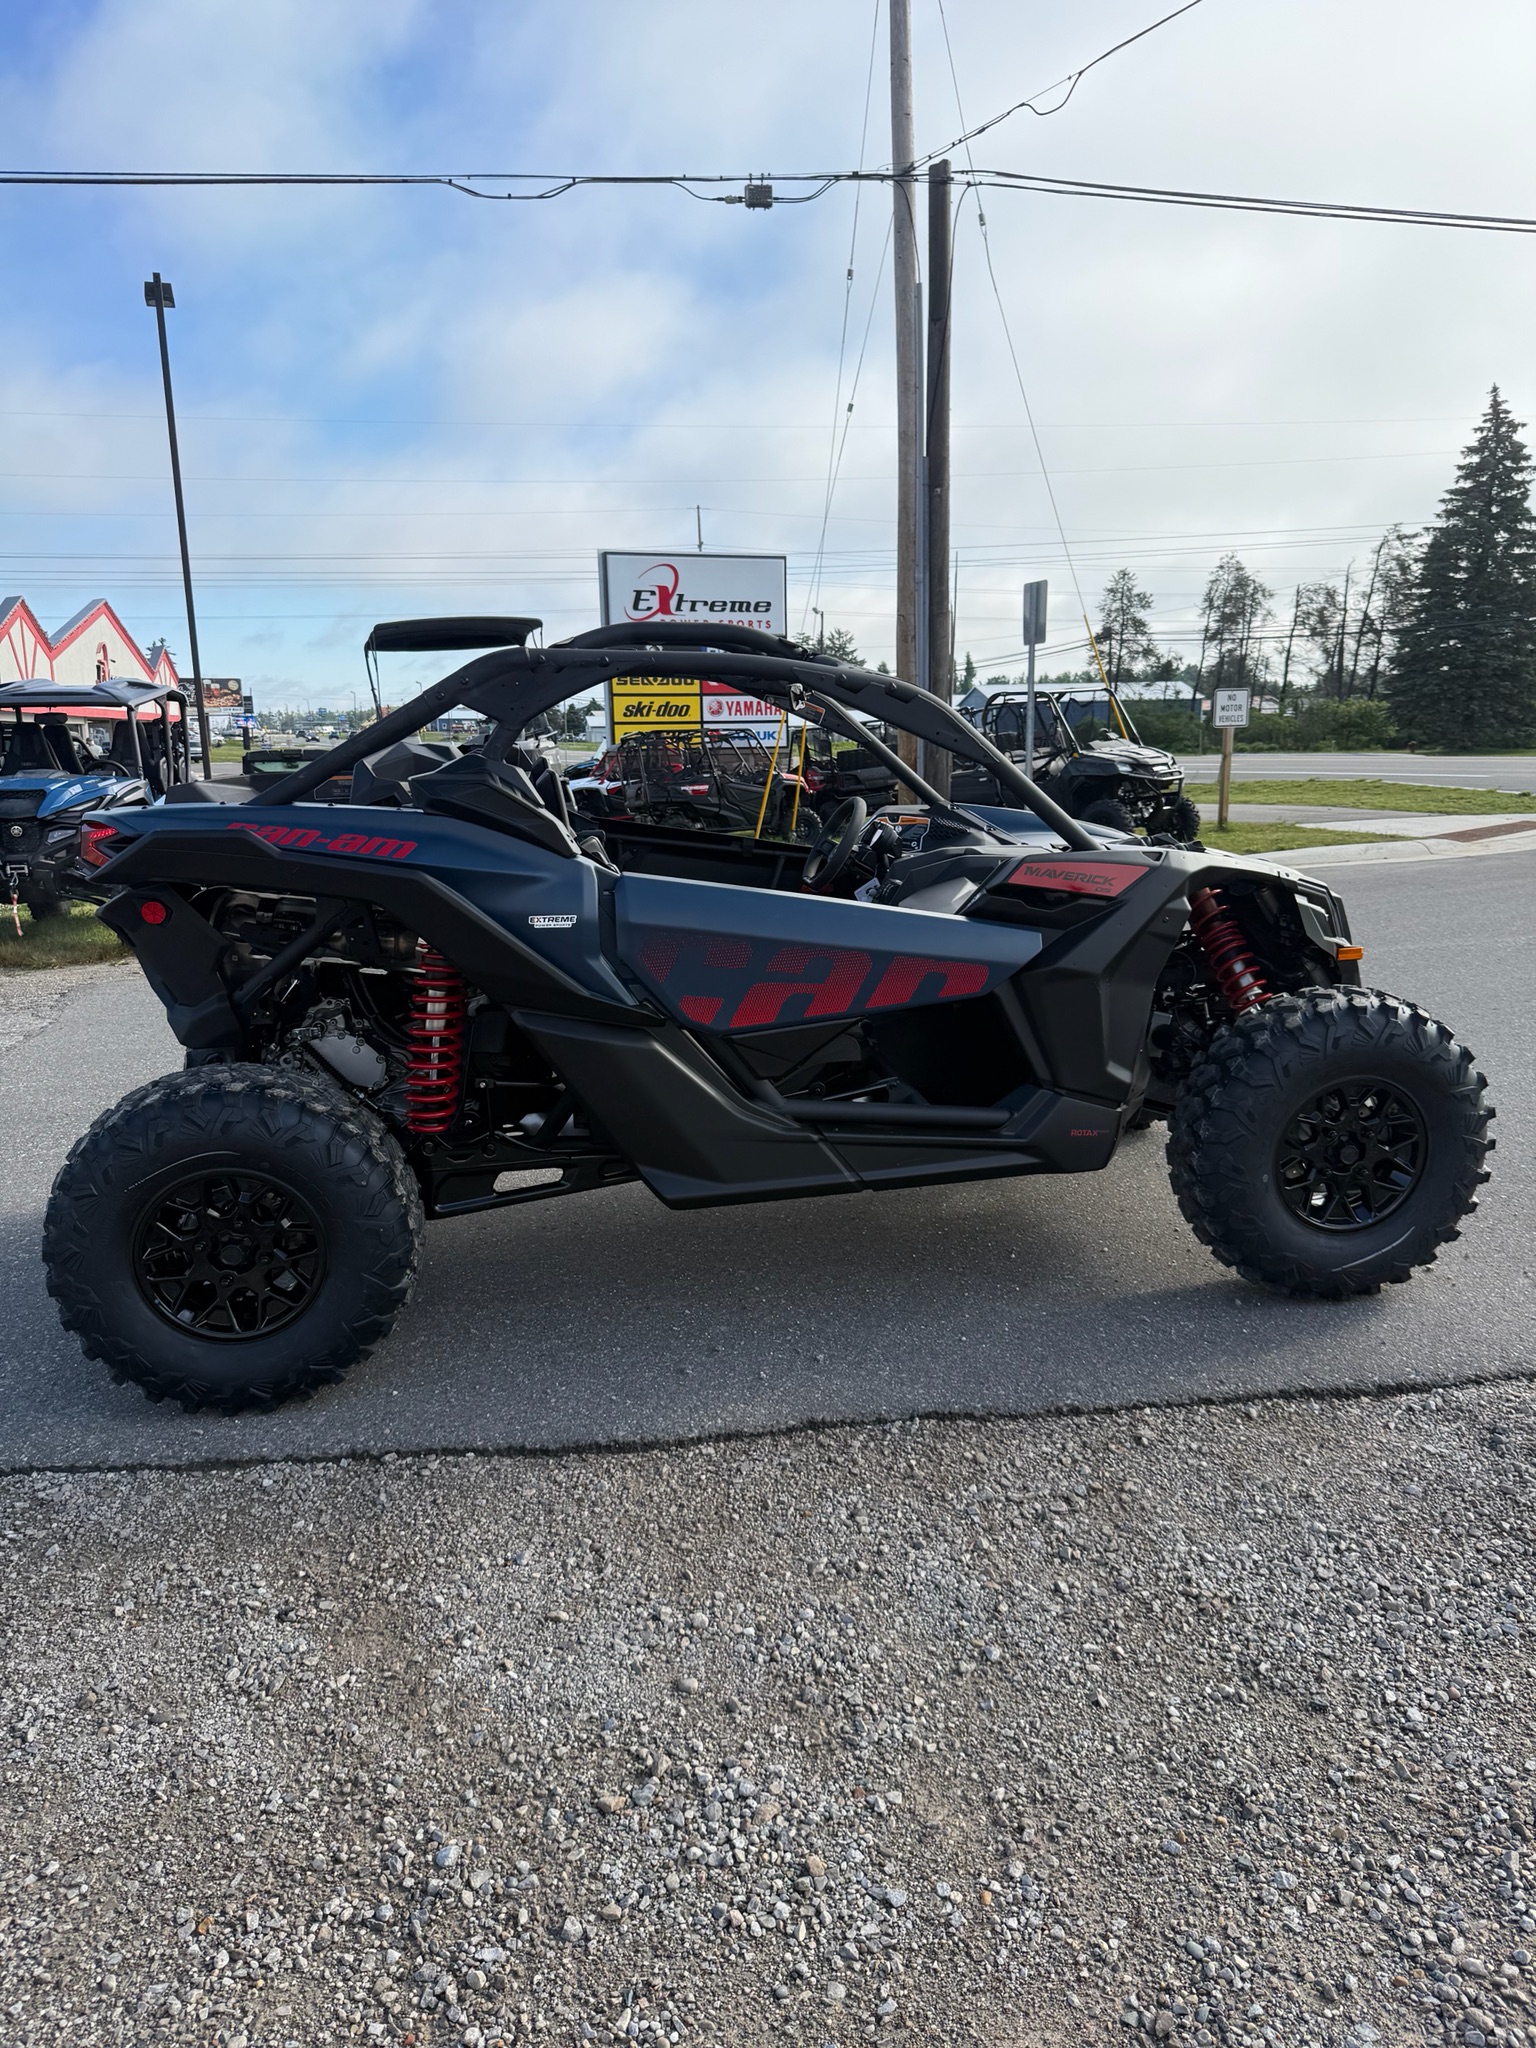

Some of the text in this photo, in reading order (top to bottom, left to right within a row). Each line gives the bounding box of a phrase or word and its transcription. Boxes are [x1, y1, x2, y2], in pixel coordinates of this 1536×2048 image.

[1227, 693, 1237, 702] NO
[726, 701, 783, 717] YAMAHA
[1220, 704, 1243, 712] MOTOR
[1218, 714, 1244, 723] VEHICLES
[1023, 865, 1117, 887] MAVERICK
[530, 916, 576, 924] EXTREME
[1070, 1129, 1098, 1137] ROTAX
